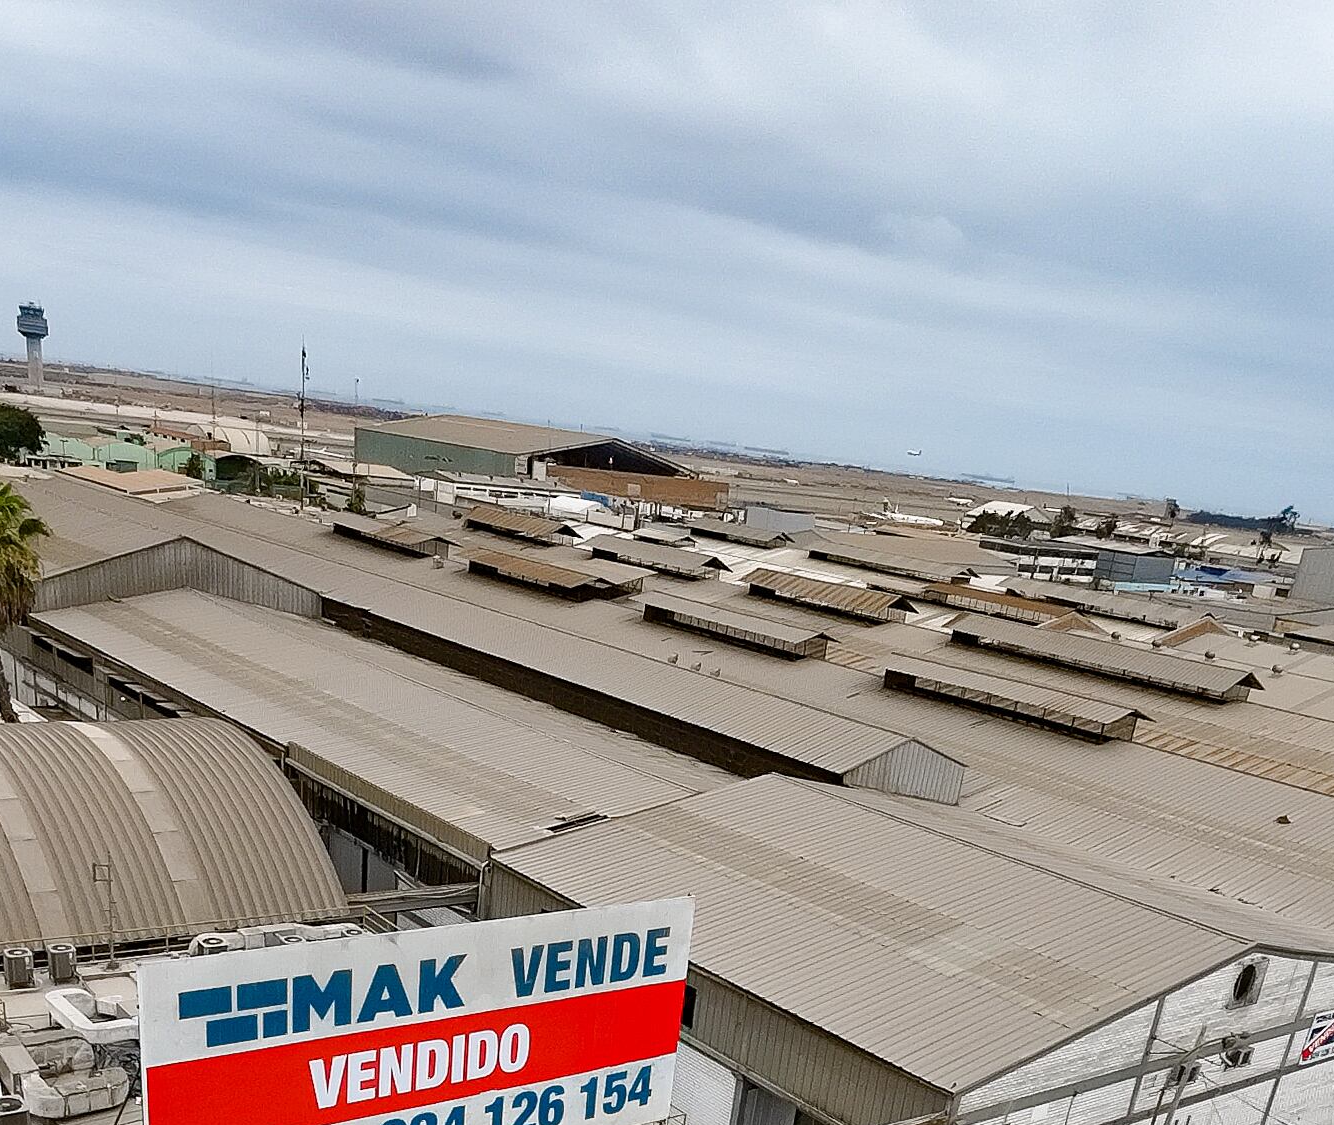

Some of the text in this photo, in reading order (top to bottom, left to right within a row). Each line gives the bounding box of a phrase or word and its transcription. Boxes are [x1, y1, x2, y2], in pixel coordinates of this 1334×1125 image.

[292, 926, 672, 1035] MAK VENDE
[308, 1022, 532, 1110] VENDIDO
[580, 1065, 653, 1120] 154
